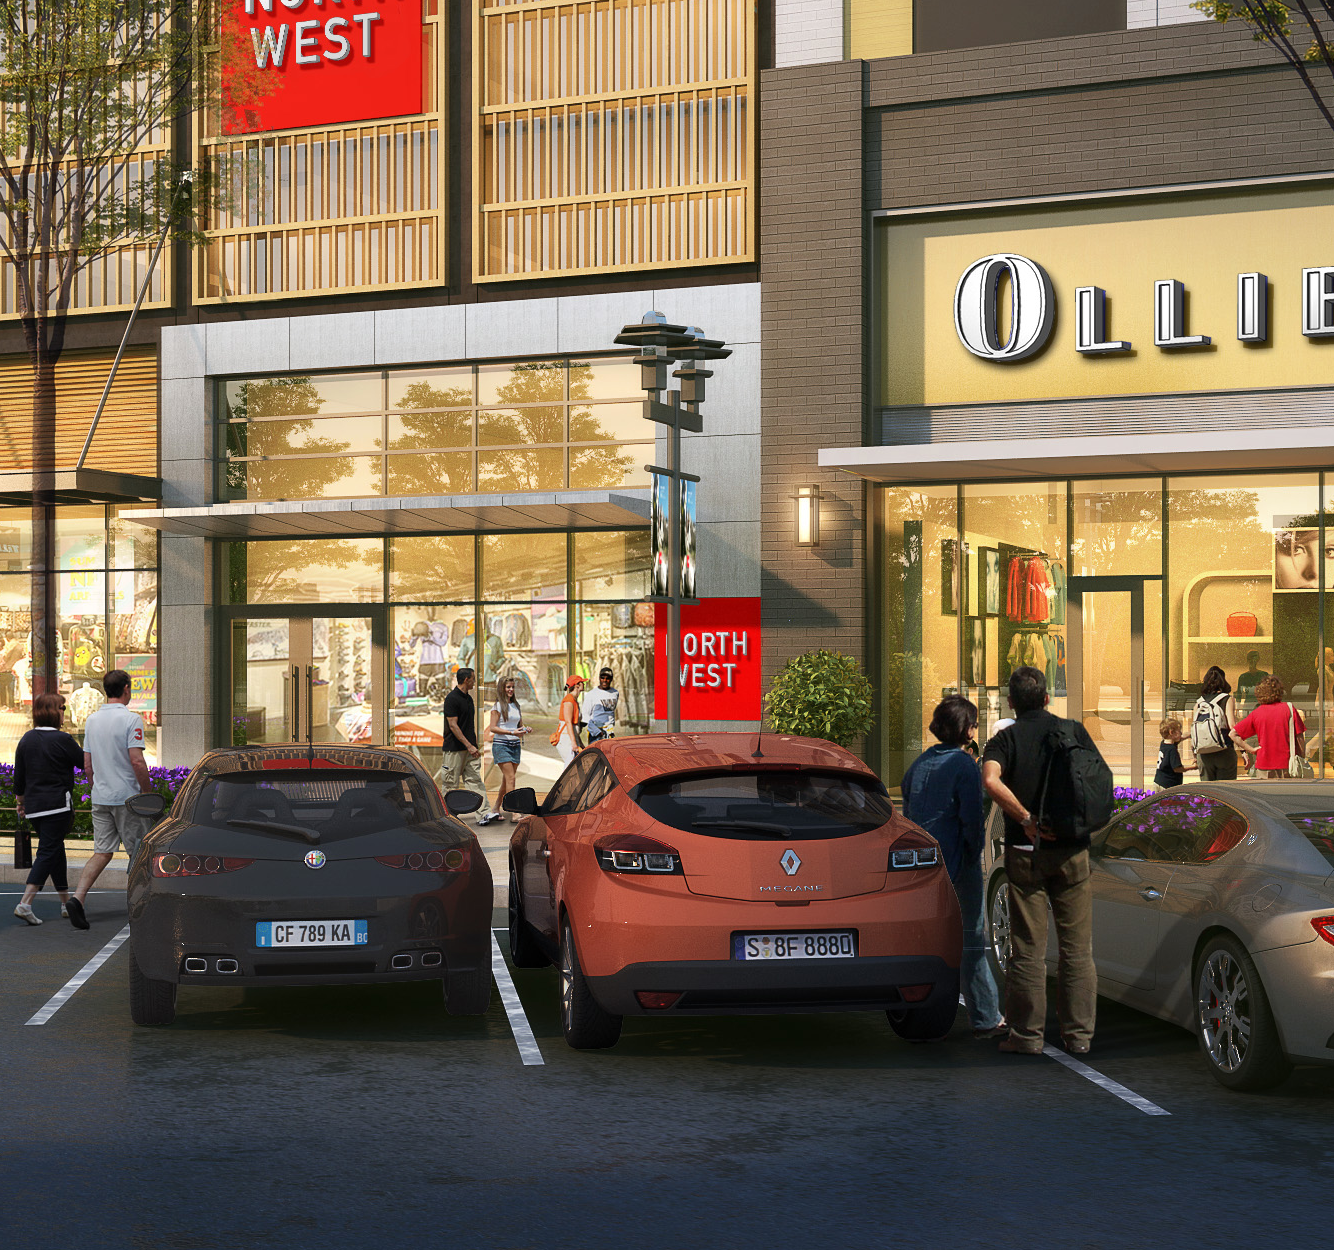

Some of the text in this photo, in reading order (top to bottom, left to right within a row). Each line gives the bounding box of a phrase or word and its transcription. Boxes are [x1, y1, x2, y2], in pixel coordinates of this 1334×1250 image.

[250, 11, 381, 69] WEST
[666, 630, 748, 657] ORTH
[130, 677, 156, 690] EW
[275, 924, 295, 943] CF
[298, 924, 327, 943] 789
[331, 923, 352, 942] KA
